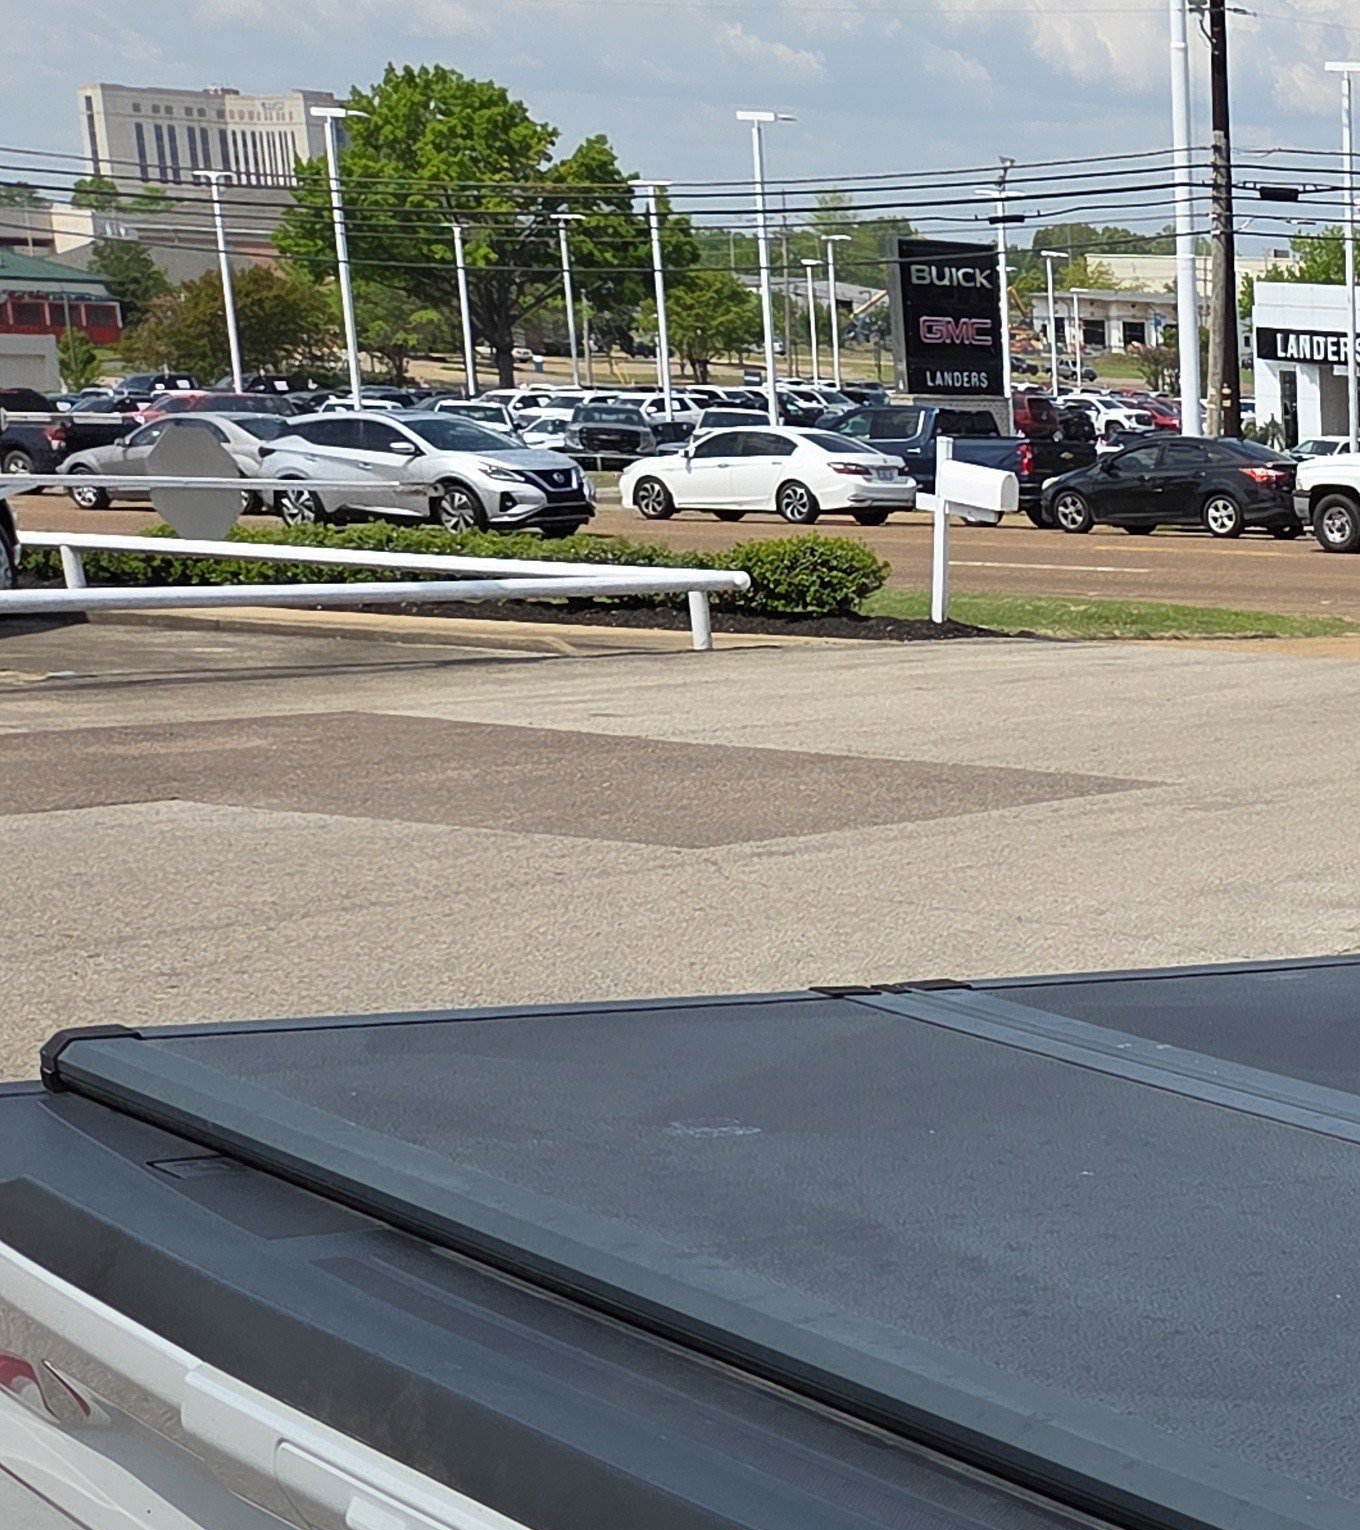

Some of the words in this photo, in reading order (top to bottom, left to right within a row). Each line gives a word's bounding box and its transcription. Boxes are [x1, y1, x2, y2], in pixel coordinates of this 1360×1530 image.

[910, 264, 993, 289] BUICK
[920, 315, 992, 345] GMC
[926, 370, 988, 388] LANDERS
